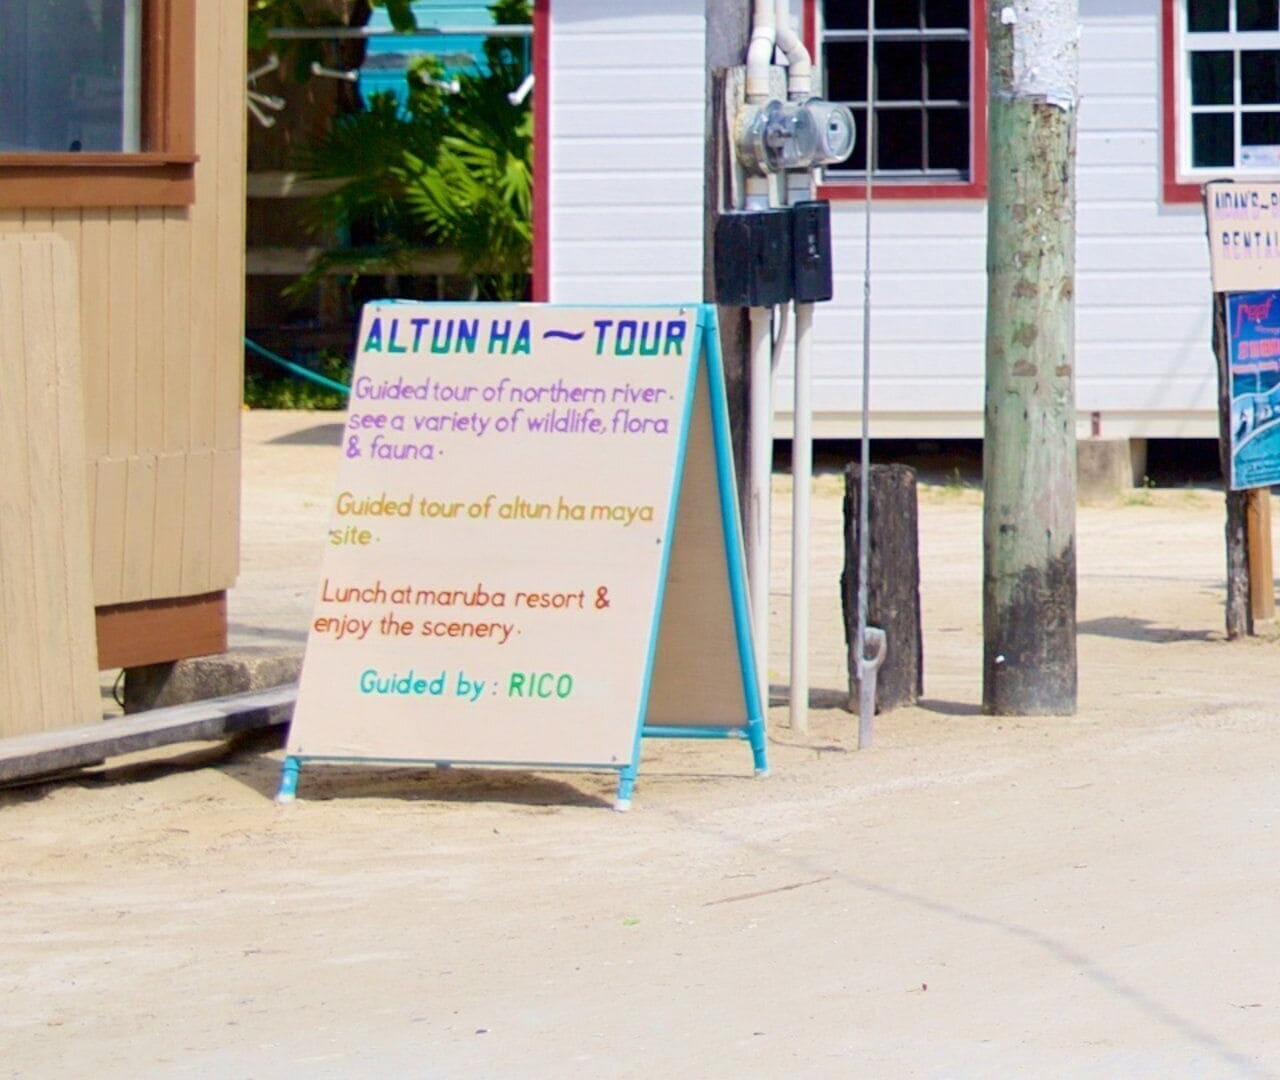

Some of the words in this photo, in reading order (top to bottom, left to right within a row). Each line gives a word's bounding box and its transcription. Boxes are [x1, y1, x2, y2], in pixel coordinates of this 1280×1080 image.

[363, 317, 479, 354] ALTUN
[487, 318, 531, 355] HA
[594, 320, 687, 357] TOUR
[355, 376, 430, 402] Guided
[433, 380, 478, 403] tour
[482, 379, 508, 403] of
[510, 380, 606, 404] northern
[348, 413, 391, 431] see
[413, 408, 490, 437] variety
[494, 409, 519, 433] of
[526, 409, 608, 437] wildlife,
[611, 410, 669, 435] flora
[345, 440, 361, 459] &
[335, 491, 414, 517] Guided
[418, 496, 465, 519] tour
[467, 494, 498, 519] of
[498, 496, 552, 520] altun
[556, 496, 585, 521] ha
[589, 501, 655, 526] maya
[414, 583, 505, 608] maruba
[514, 587, 585, 610] resort
[594, 586, 611, 611] &
[313, 614, 373, 641] enjoy
[380, 616, 414, 638] the
[360, 668, 446, 697] Guided
[508, 671, 573, 700] RICO
